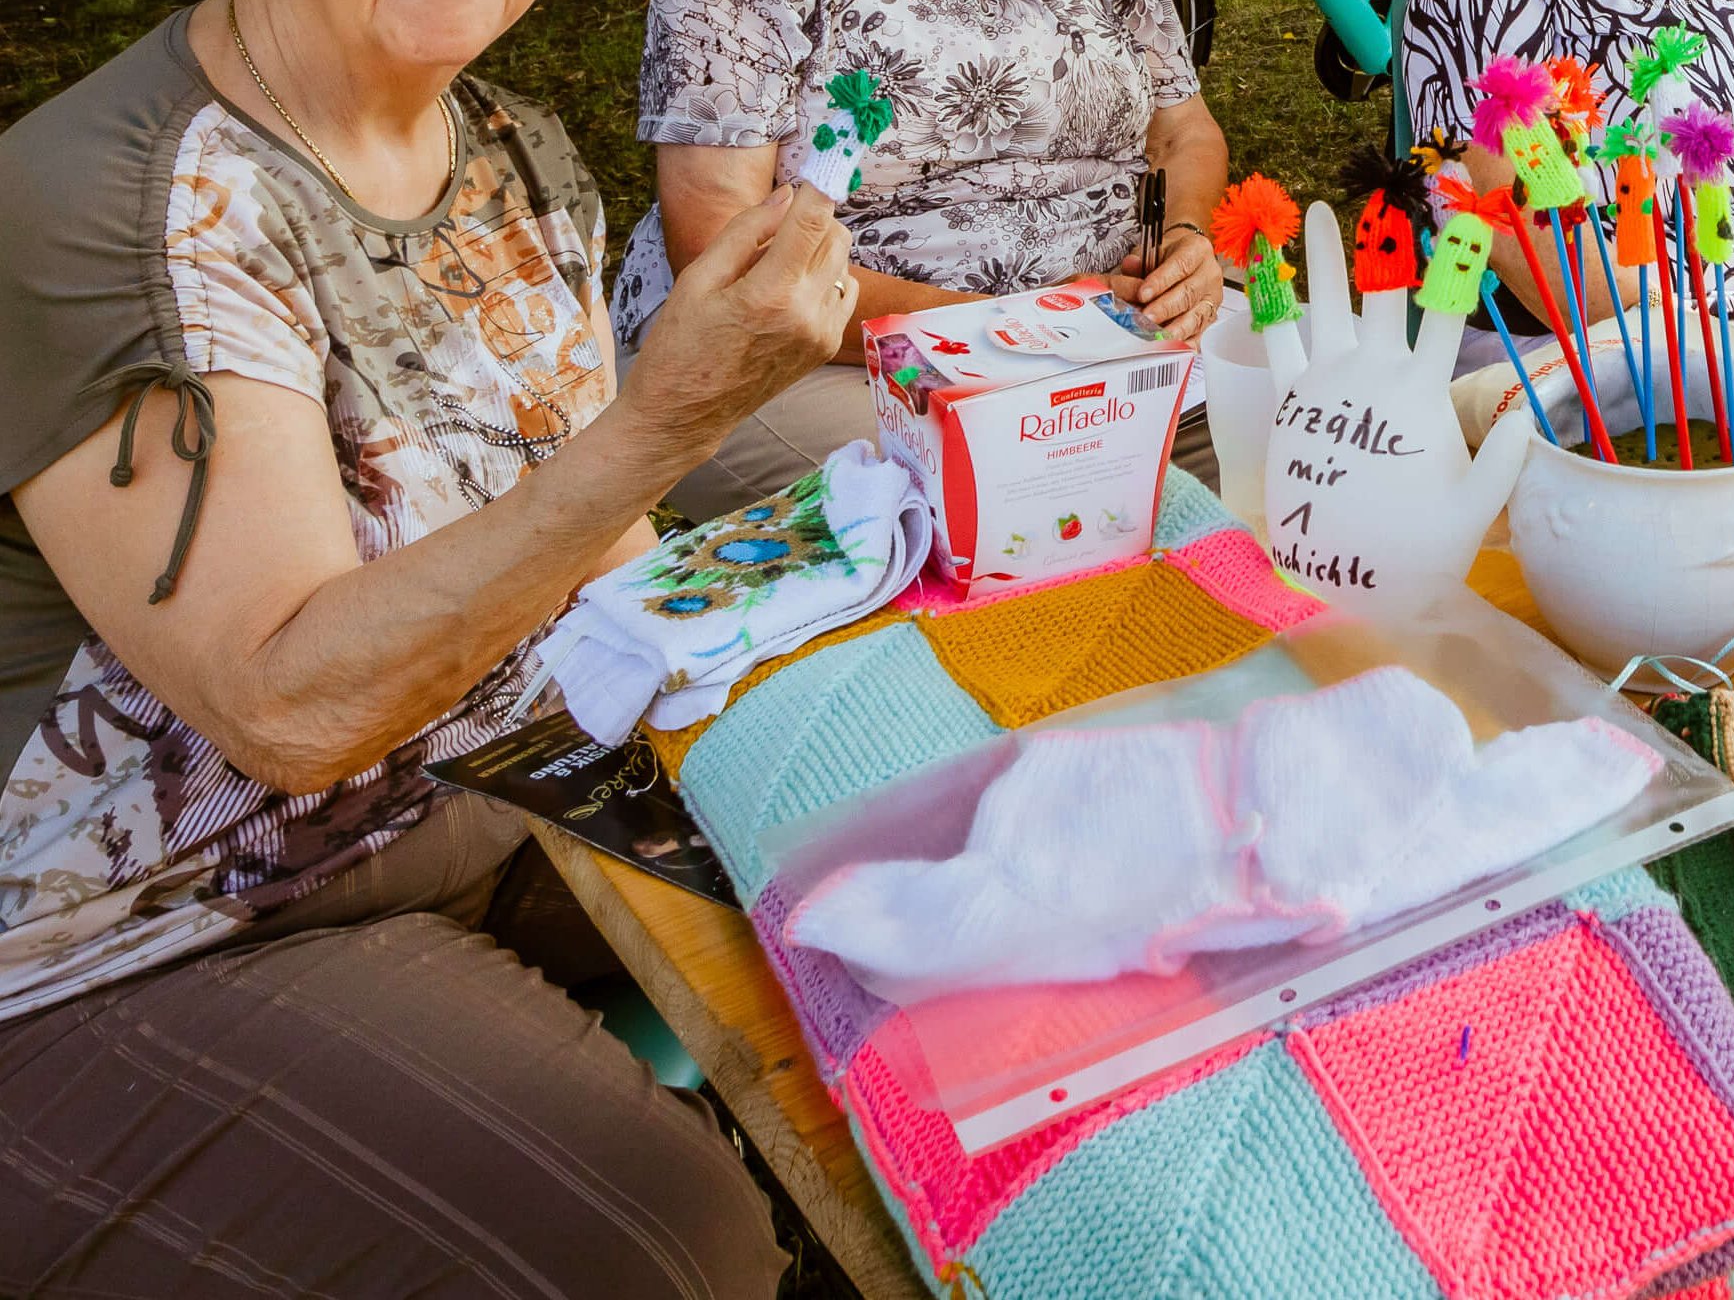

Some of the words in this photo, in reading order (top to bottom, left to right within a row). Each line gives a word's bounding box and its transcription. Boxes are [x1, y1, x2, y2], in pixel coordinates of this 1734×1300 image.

[874, 382, 937, 475] Raffaello
[1020, 397, 1135, 442] Raffaello
[1047, 440, 1104, 460] HIMBEERE
[1287, 456, 1347, 486] mir
[1281, 501, 1312, 535] 1
